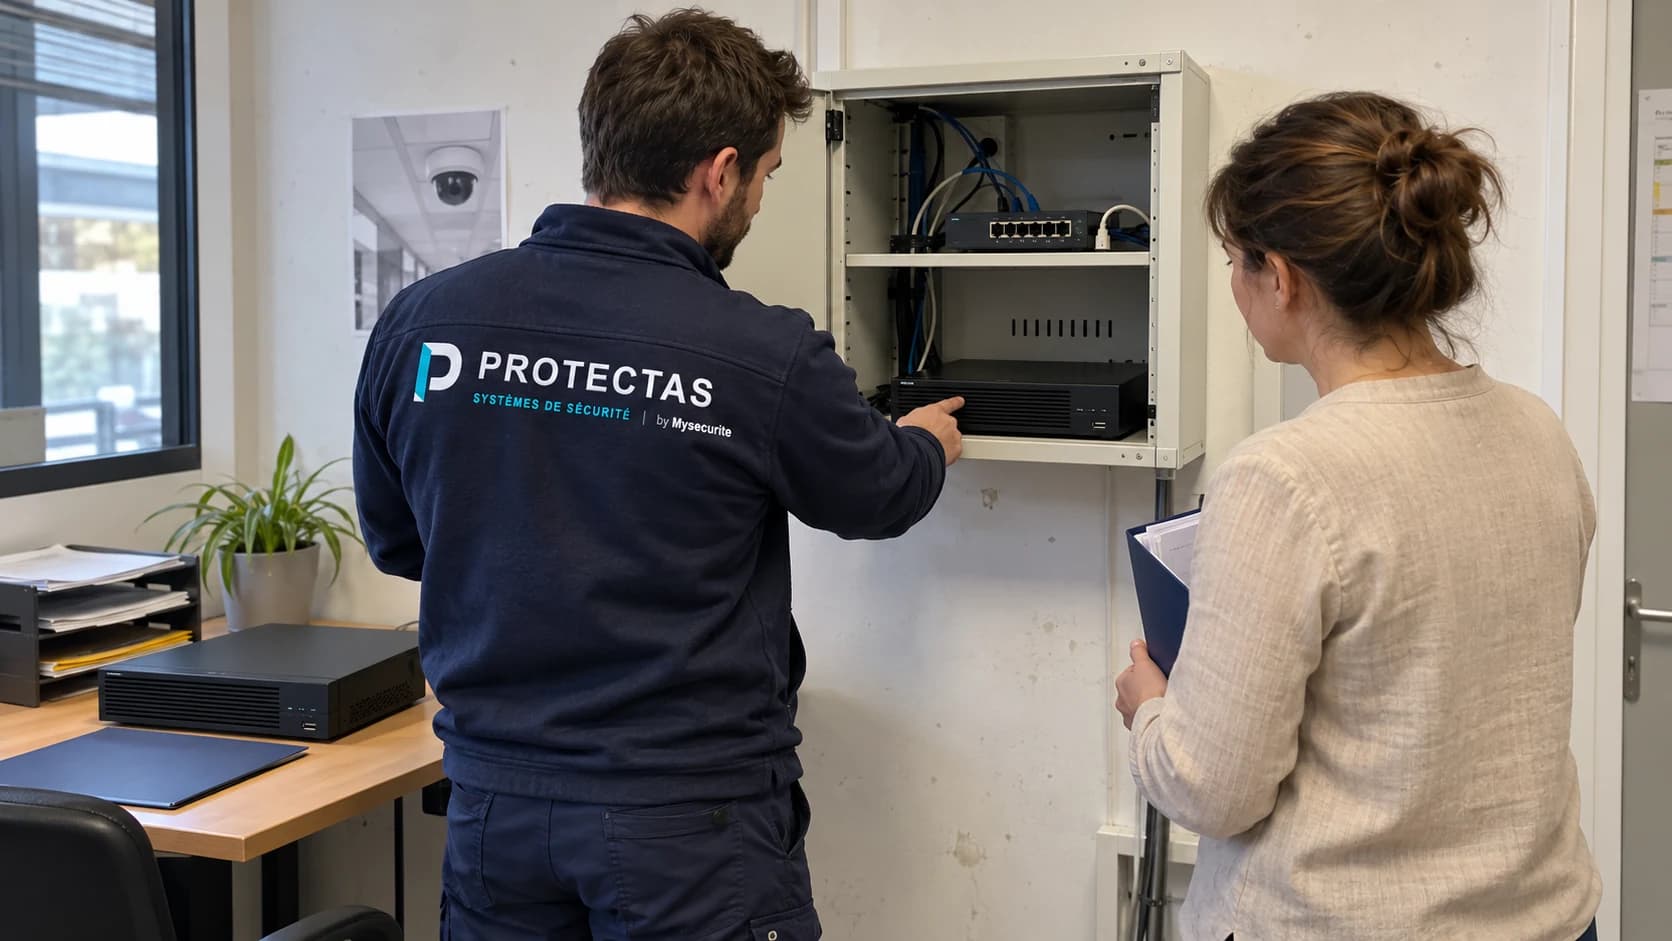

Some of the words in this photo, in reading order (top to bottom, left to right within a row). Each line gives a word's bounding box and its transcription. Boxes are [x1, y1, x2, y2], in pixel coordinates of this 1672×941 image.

[478, 351, 713, 408] PROTECTAS
[473, 392, 539, 410] SYSTÈMES
[544, 400, 562, 413] DE
[566, 400, 631, 420] SÉCURITÉ
[656, 414, 670, 430] by
[672, 417, 733, 437] Mysecurite
